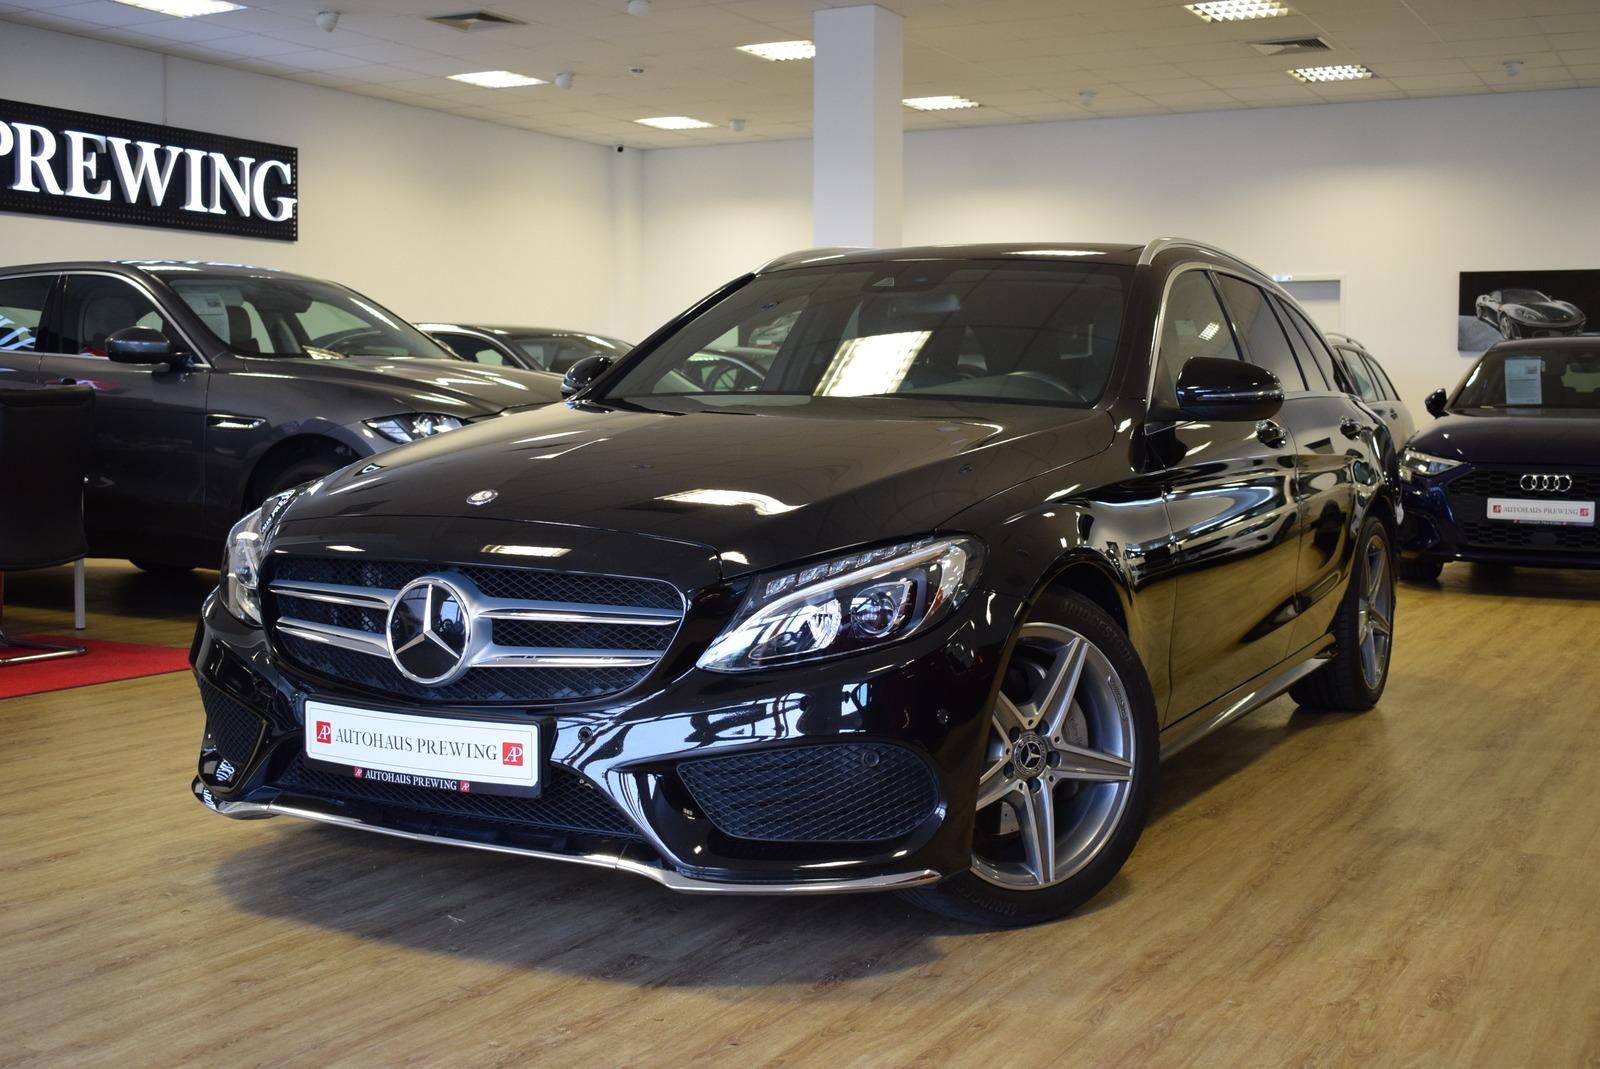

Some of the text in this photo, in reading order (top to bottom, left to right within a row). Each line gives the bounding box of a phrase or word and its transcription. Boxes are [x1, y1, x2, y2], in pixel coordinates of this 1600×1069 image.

[1504, 506, 1542, 514] AUTOHAUS
[1543, 507, 1578, 516] PREWING
[335, 727, 413, 753] AUTOHAUS
[417, 738, 497, 761] PREWING
[365, 769, 412, 785] AUTOHAUS
[413, 776, 457, 791] PREWING
